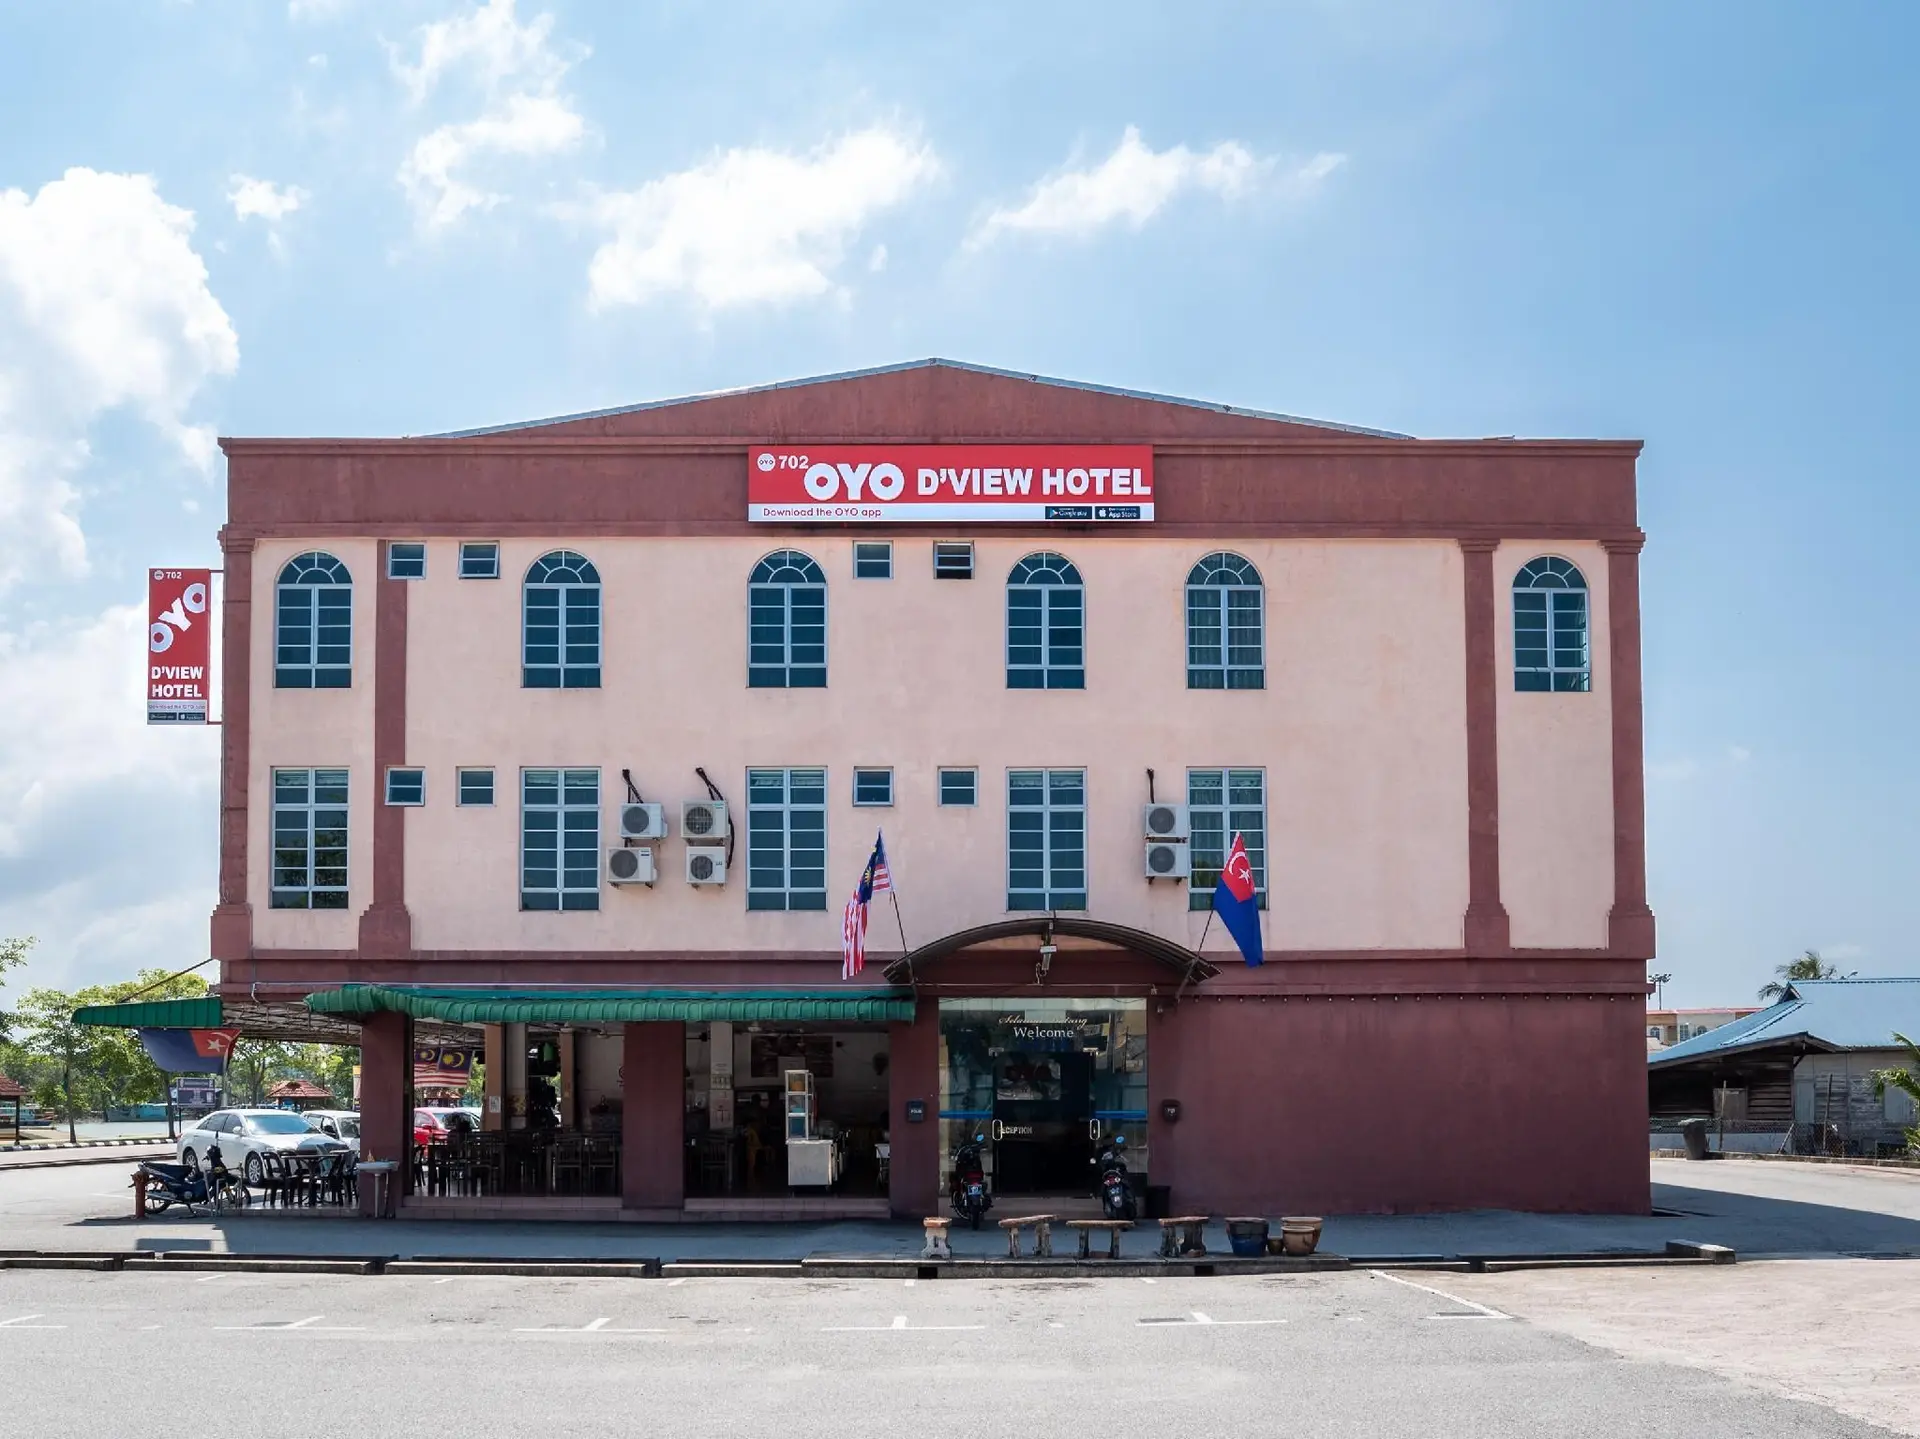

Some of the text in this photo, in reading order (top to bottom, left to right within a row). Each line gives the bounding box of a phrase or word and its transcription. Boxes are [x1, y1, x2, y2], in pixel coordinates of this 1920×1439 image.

[778, 455, 809, 470] 702
[803, 462, 1152, 501] OYO D'VIEW HOTEL
[763, 507, 882, 519] Download the OYO app
[165, 571, 182, 580] 702
[150, 582, 206, 653] OYO
[151, 666, 204, 680] D'VIEW
[151, 684, 203, 698] HOTEL
[1013, 1025, 1075, 1038] Welcome
